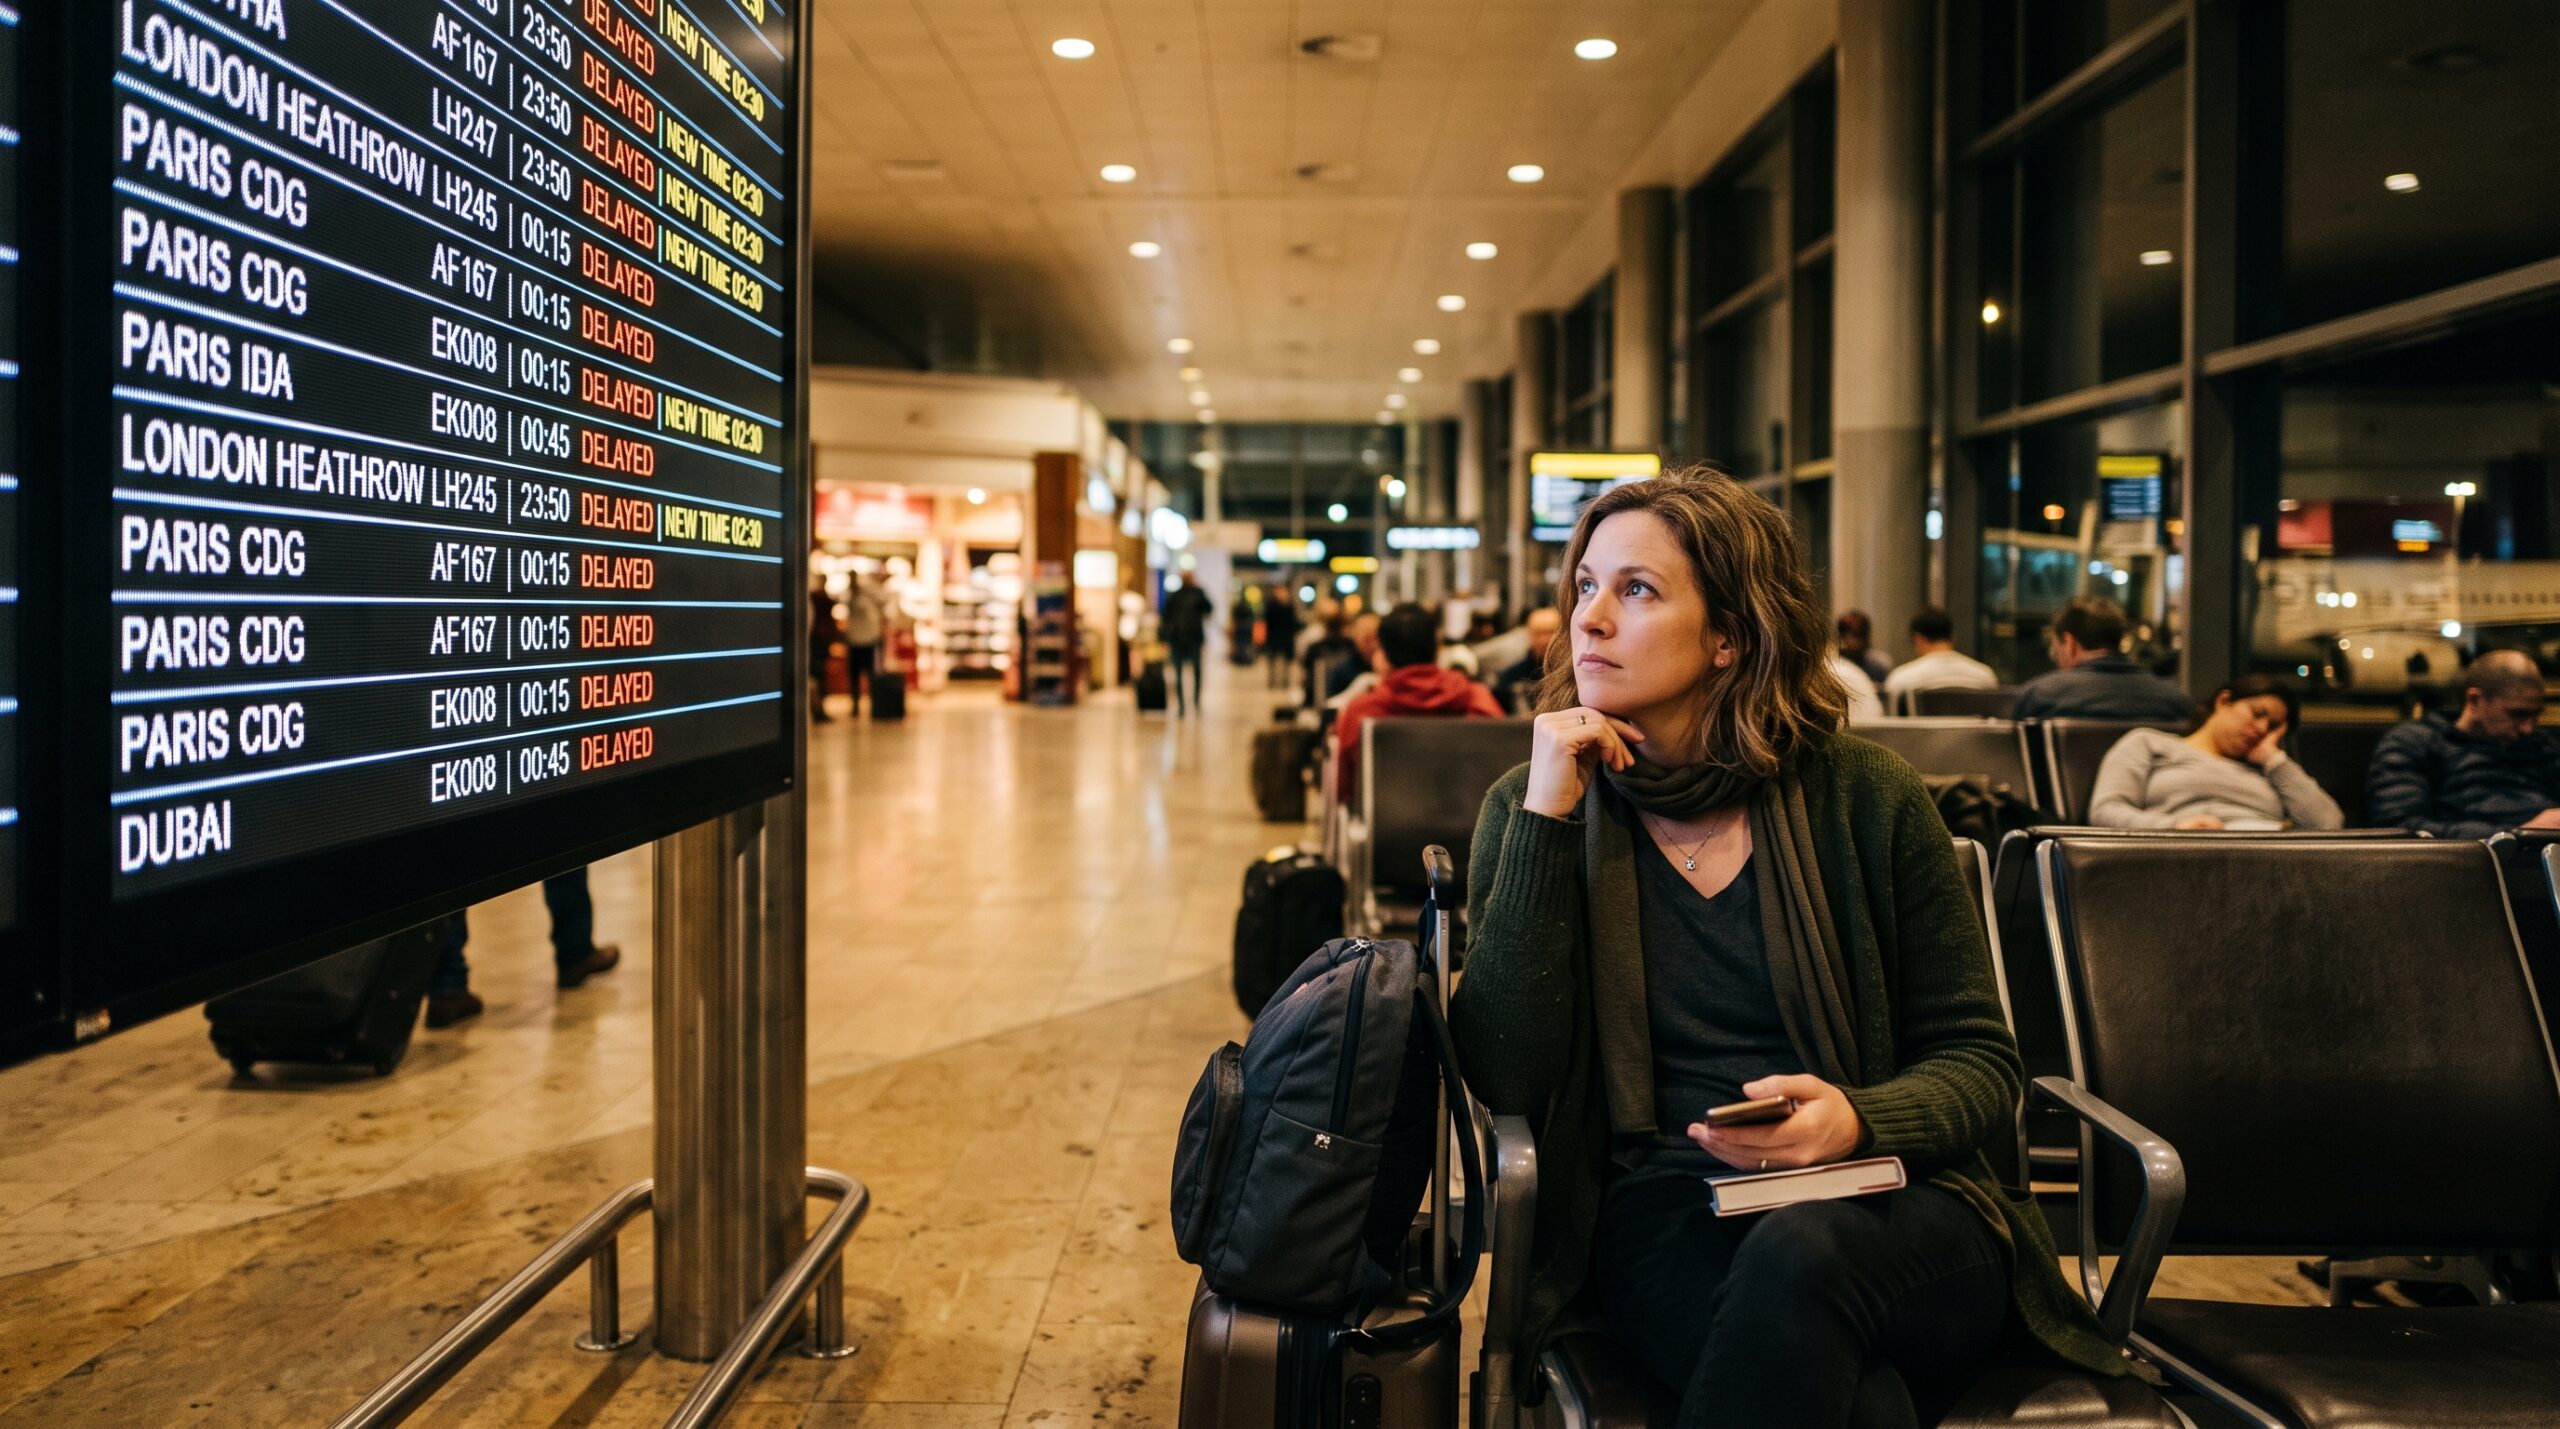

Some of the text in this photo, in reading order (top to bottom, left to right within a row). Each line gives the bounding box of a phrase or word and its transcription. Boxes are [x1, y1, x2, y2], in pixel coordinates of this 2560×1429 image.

[520, 3, 572, 70] 23:50
[583, 51, 656, 133] DELAYED
[665, 117, 699, 168] NEW
[699, 143, 732, 193] TIME
[583, 0, 656, 76] DELAYED
[665, 4, 699, 60] NEW
[699, 36, 732, 93] TIME
[121, 0, 269, 122] LONDON
[277, 81, 426, 196] HEATHROW
[431, 164, 498, 232] LH245
[520, 211, 572, 267] 00:15
[582, 242, 655, 307] DELAYED
[431, 12, 498, 86] AF167
[520, 73, 572, 136] 23:50
[583, 115, 656, 192] DELAYED
[665, 173, 699, 221] NEW
[699, 196, 732, 245] TIME
[431, 87, 498, 158] LH247
[520, 142, 572, 202] 23:50
[582, 179, 655, 249] DELAYED
[665, 229, 699, 275] NEW
[699, 249, 732, 295] TIME
[121, 103, 655, 364] PARIS CDG AF167 00:15 DELAYED
[121, 207, 232, 293] PARIS
[239, 251, 307, 315] CDG
[431, 316, 498, 374] EK008
[520, 348, 572, 395] 00:15
[581, 367, 654, 420] DELAYED
[665, 395, 699, 434] NEW
[699, 406, 732, 445] TIME
[122, 310, 232, 387] PARIS
[431, 391, 498, 444] EK008
[520, 415, 572, 459] 00:45
[581, 430, 654, 477] DELAYED
[121, 515, 654, 590] PARIS CDG AF167 00:15 DELAYED
[122, 413, 268, 486] LONDON
[276, 440, 426, 505] HEATHROW
[431, 467, 498, 514] LH245
[520, 481, 572, 523] 23:50
[581, 492, 654, 533] DELAYED
[665, 505, 699, 539] NEW
[699, 510, 732, 544] TIME
[121, 614, 654, 671] PARIS CDG AF167 00:15 DELAYED
[120, 726, 653, 872] DUBAI EK008 00:45 DELAYED
[121, 671, 654, 772] PARIS CDG EK008 00:15 DELAYED
